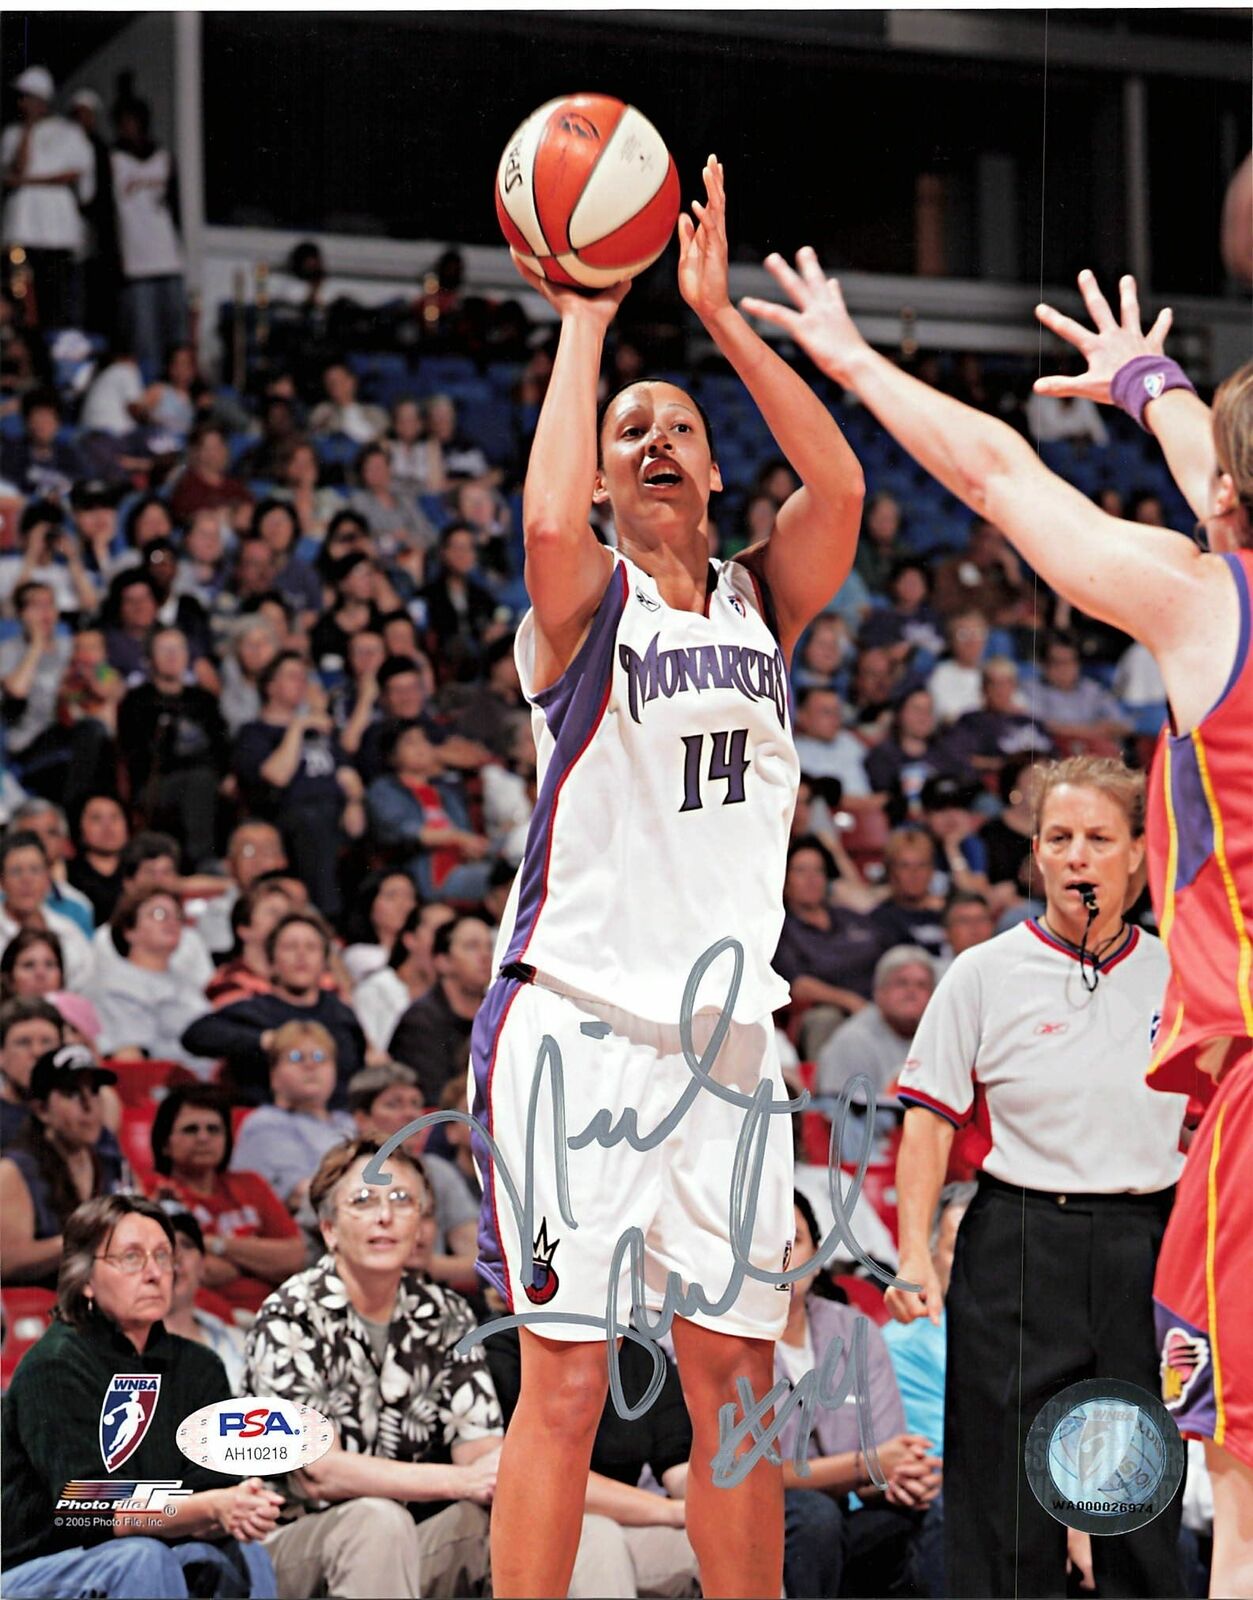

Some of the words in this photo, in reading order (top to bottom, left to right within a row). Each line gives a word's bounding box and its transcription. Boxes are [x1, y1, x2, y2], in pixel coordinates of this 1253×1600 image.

[618, 631, 786, 730] MONARCHS
[678, 728, 752, 812] 14
[219, 1408, 294, 1438] PSA
[224, 1447, 288, 1461] AH10218
[1052, 1501, 1154, 1514] WA000026974
